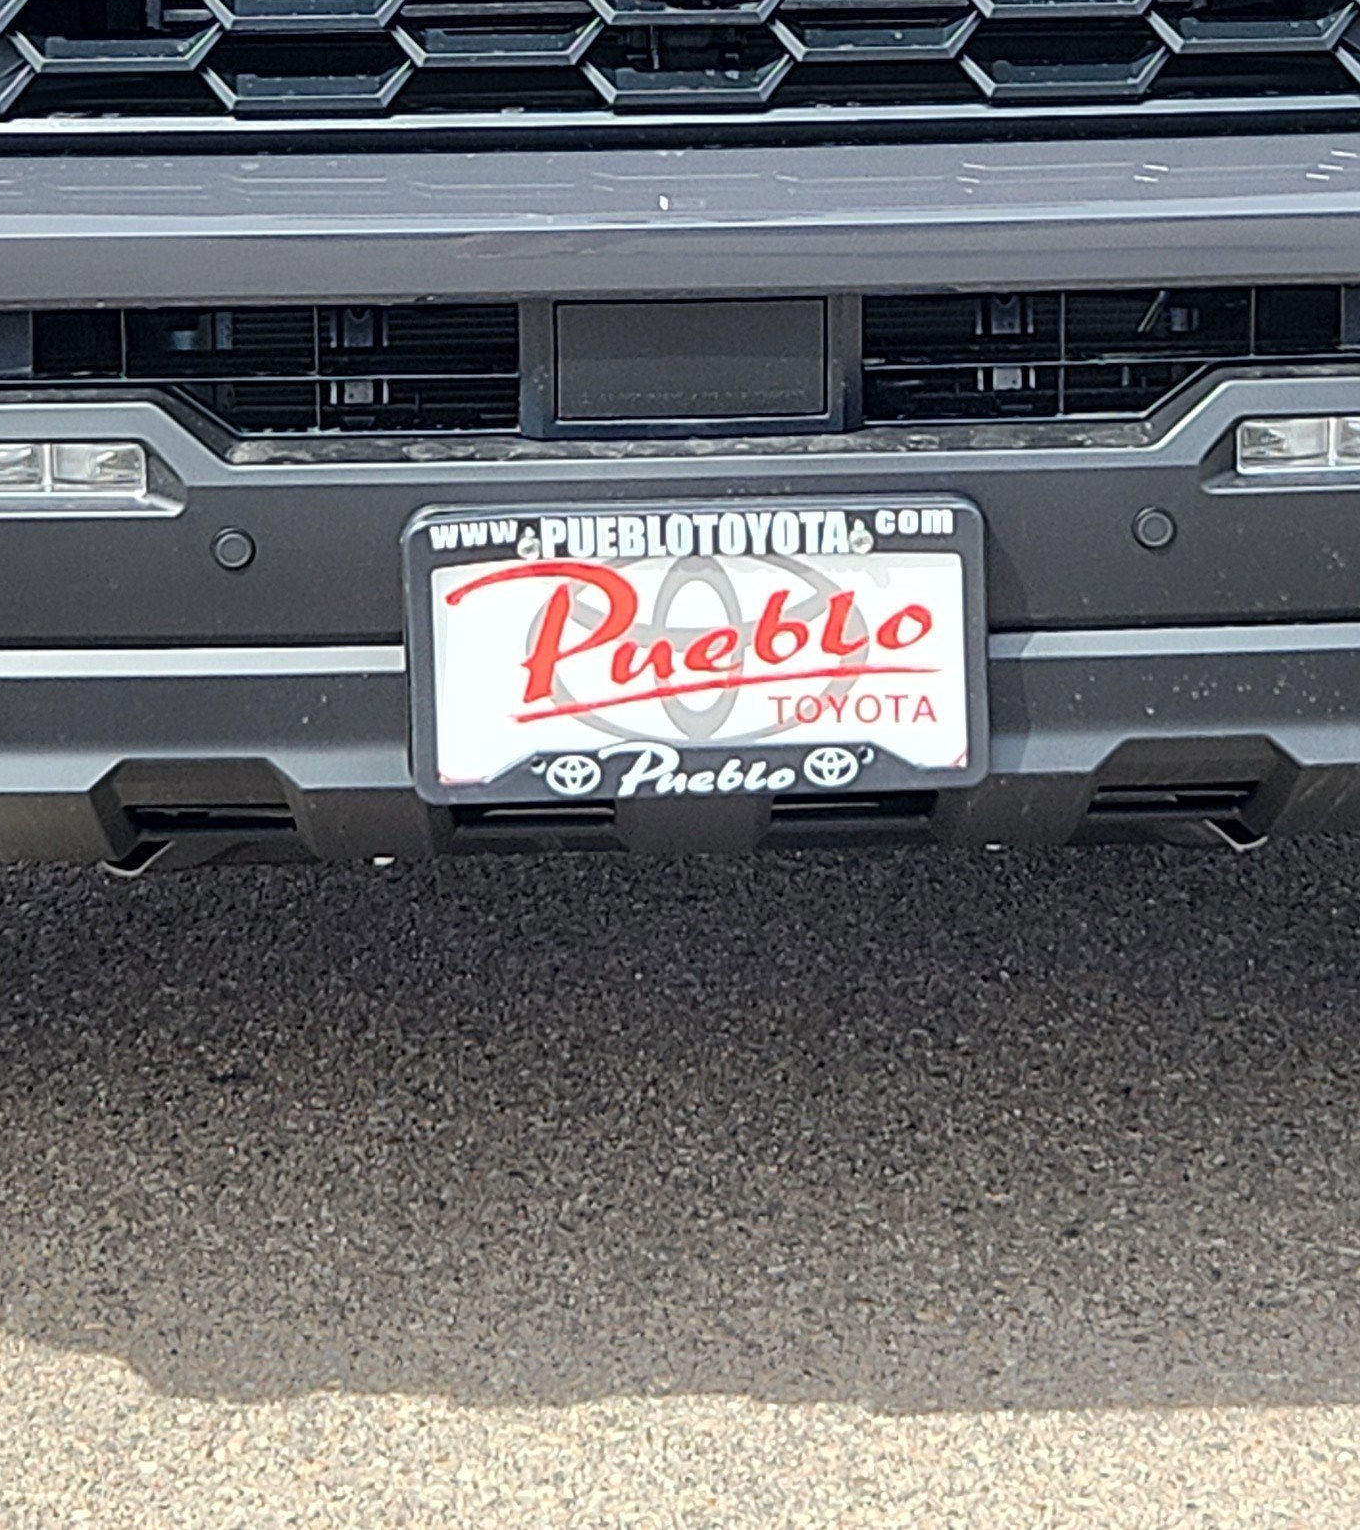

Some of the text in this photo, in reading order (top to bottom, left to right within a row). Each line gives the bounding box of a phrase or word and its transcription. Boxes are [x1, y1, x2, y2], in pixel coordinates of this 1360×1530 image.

[445, 560, 933, 705] Pueblo
[768, 694, 938, 724] TOYOTA
[598, 740, 797, 797] Pueblo
